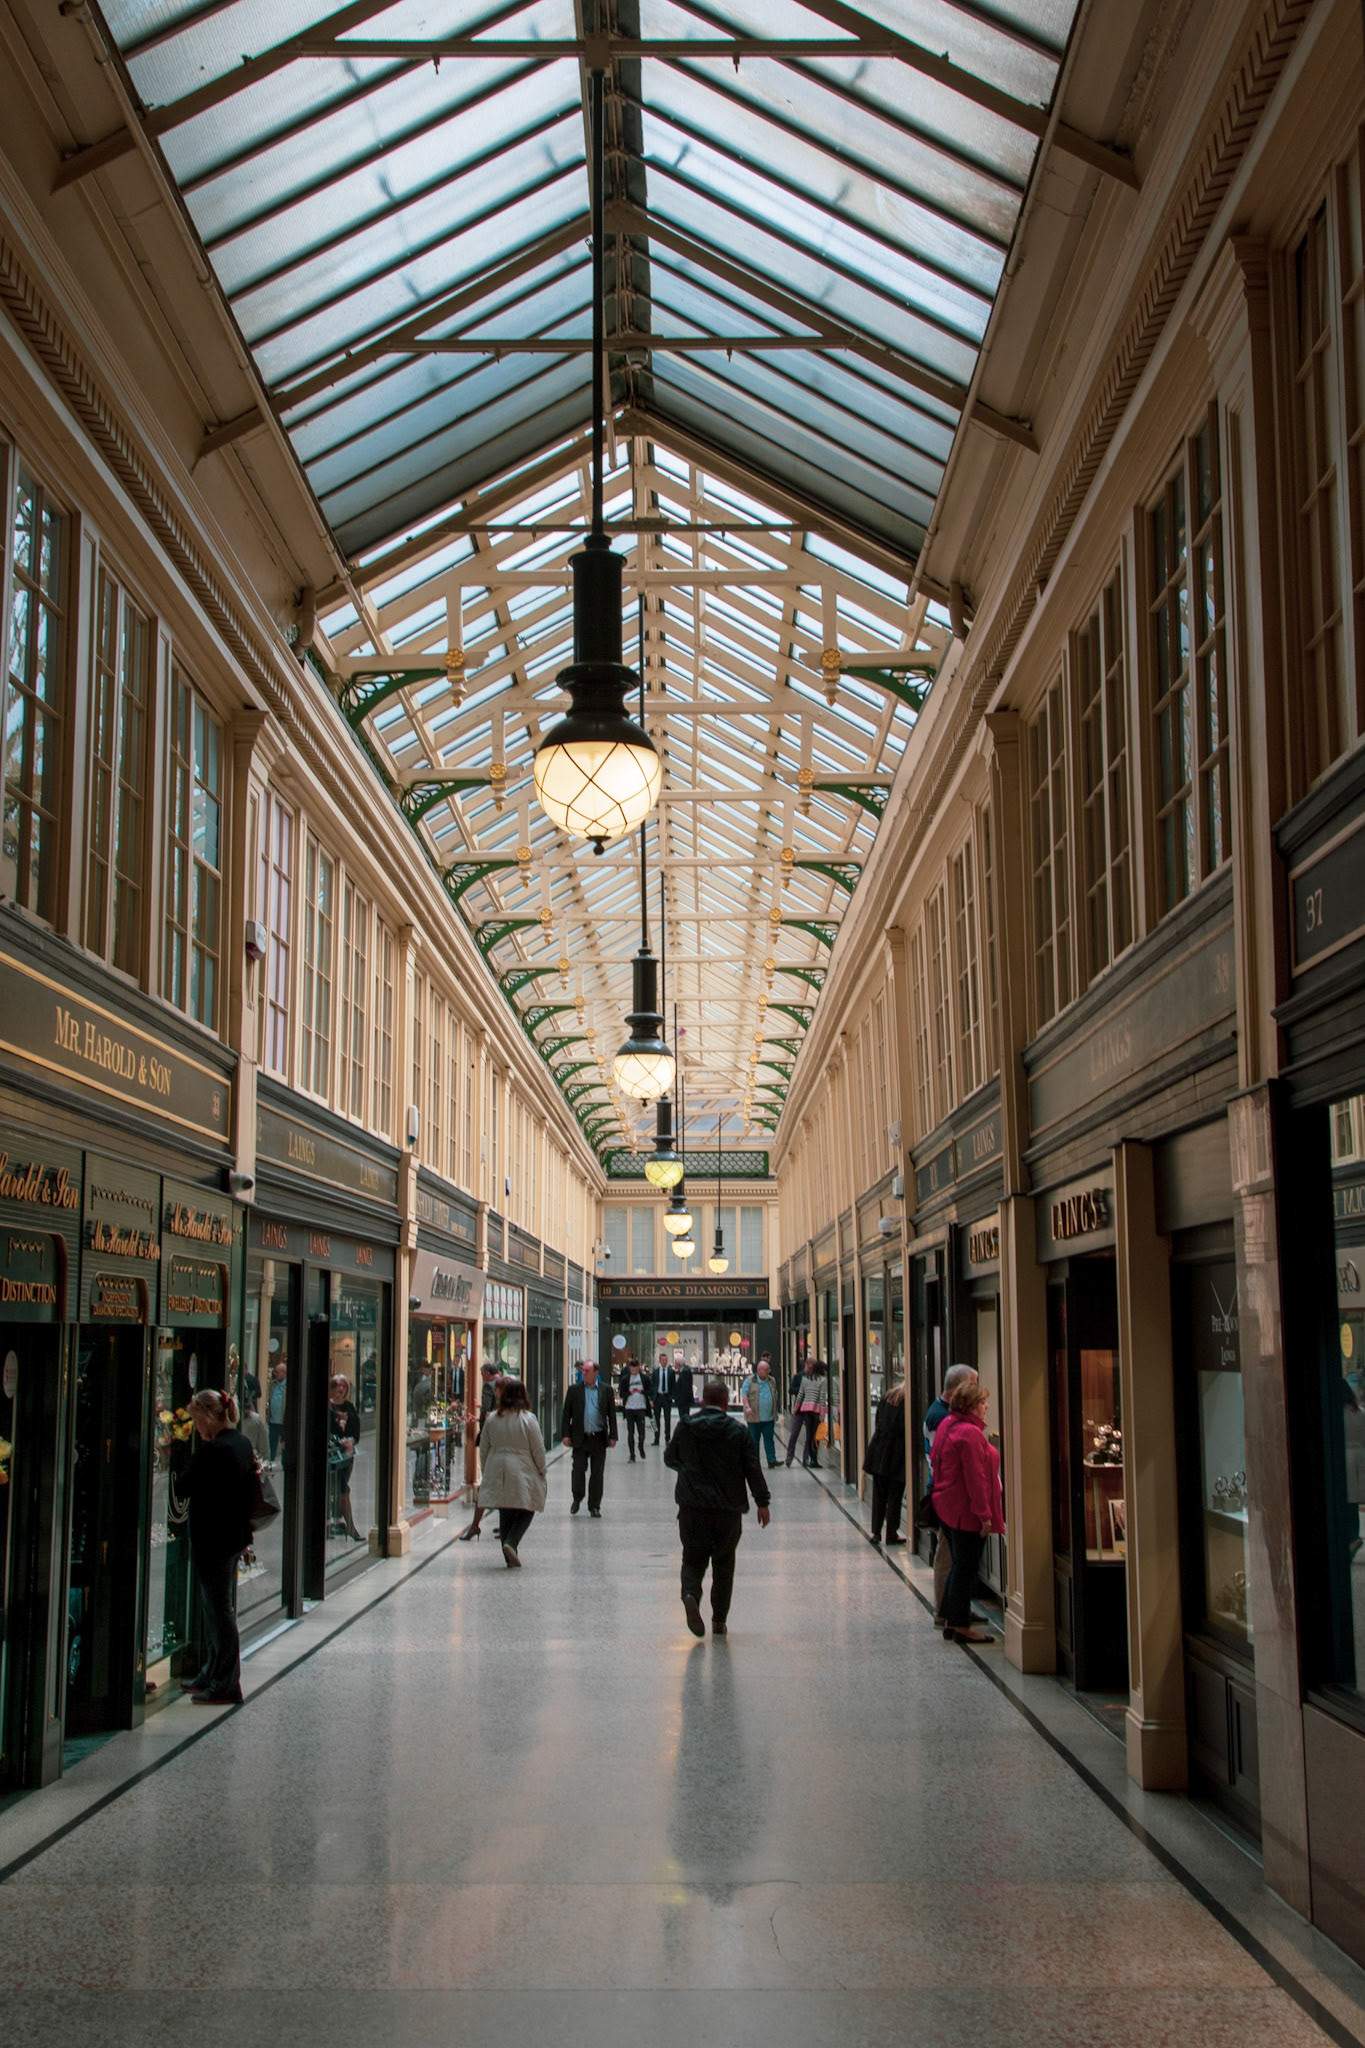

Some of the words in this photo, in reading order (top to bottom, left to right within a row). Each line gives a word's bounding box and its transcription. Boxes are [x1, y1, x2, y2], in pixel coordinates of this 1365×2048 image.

[1306, 888, 1324, 933] 37
[1215, 952, 1229, 994] 38
[83, 1021, 136, 1080] HAROLD
[138, 1055, 147, 1086] &
[149, 1057, 172, 1096] SON
[1090, 1018, 1131, 1082] LAINGS
[288, 1131, 315, 1166] LAINGS
[973, 1122, 995, 1160] LAINGS
[41, 1183, 51, 1204] &
[53, 1167, 79, 1210] Son
[1051, 1190, 1102, 1241] LAINGS
[106, 1224, 140, 1257] Harold
[145, 1232, 160, 1261] Son
[261, 1221, 287, 1249] LAINGS
[309, 1232, 330, 1257] LAINGS
[968, 1229, 997, 1263] LAINGS
[355, 1243, 373, 1266] LAINGS
[2, 1278, 57, 1304] DISTINCTION
[603, 1286, 611, 1295] 10
[619, 1286, 681, 1296] BARCLAYS
[685, 1286, 749, 1295] DIAMONDS
[755, 1286, 765, 1295] 10
